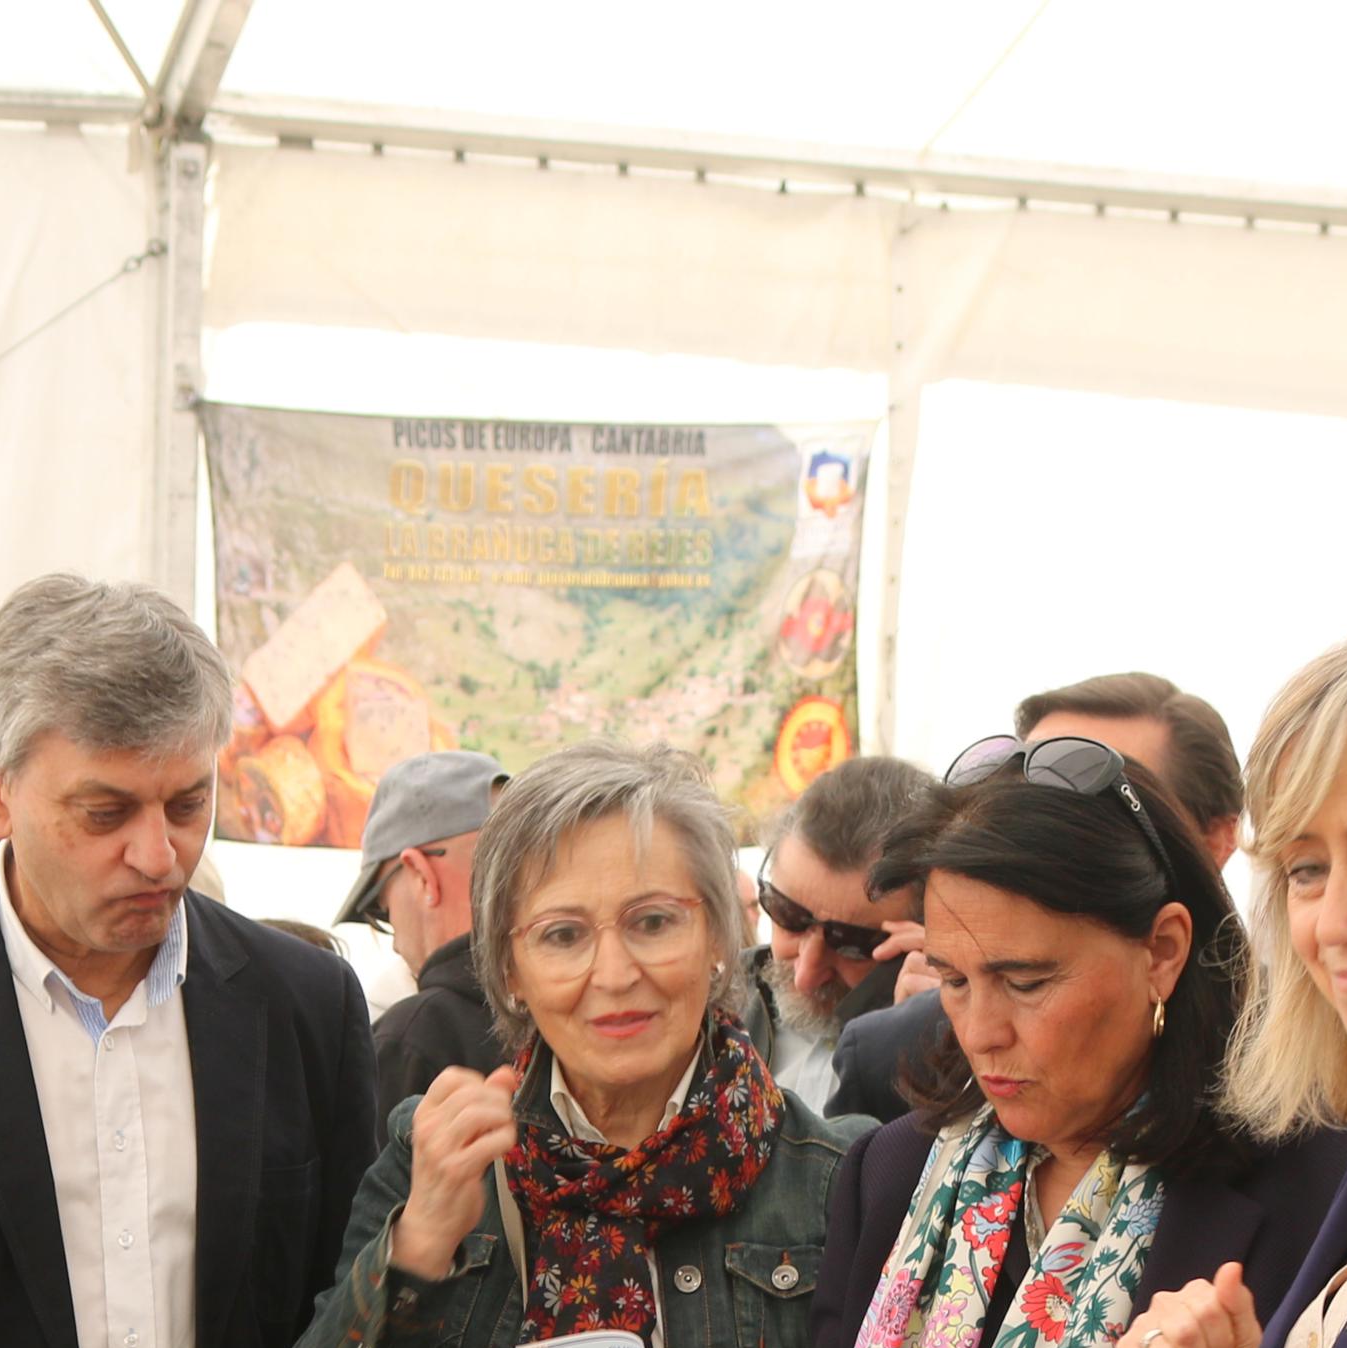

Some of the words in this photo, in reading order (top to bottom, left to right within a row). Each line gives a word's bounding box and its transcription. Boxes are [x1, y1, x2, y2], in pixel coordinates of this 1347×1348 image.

[394, 421, 456, 449] PICOS
[462, 423, 487, 450] DE
[492, 424, 572, 453] EUROPA
[591, 426, 707, 456] CANTABRIA
[388, 457, 712, 518] QUESERÍA
[383, 520, 418, 558] LA
[426, 518, 576, 564] BRAÑUCA
